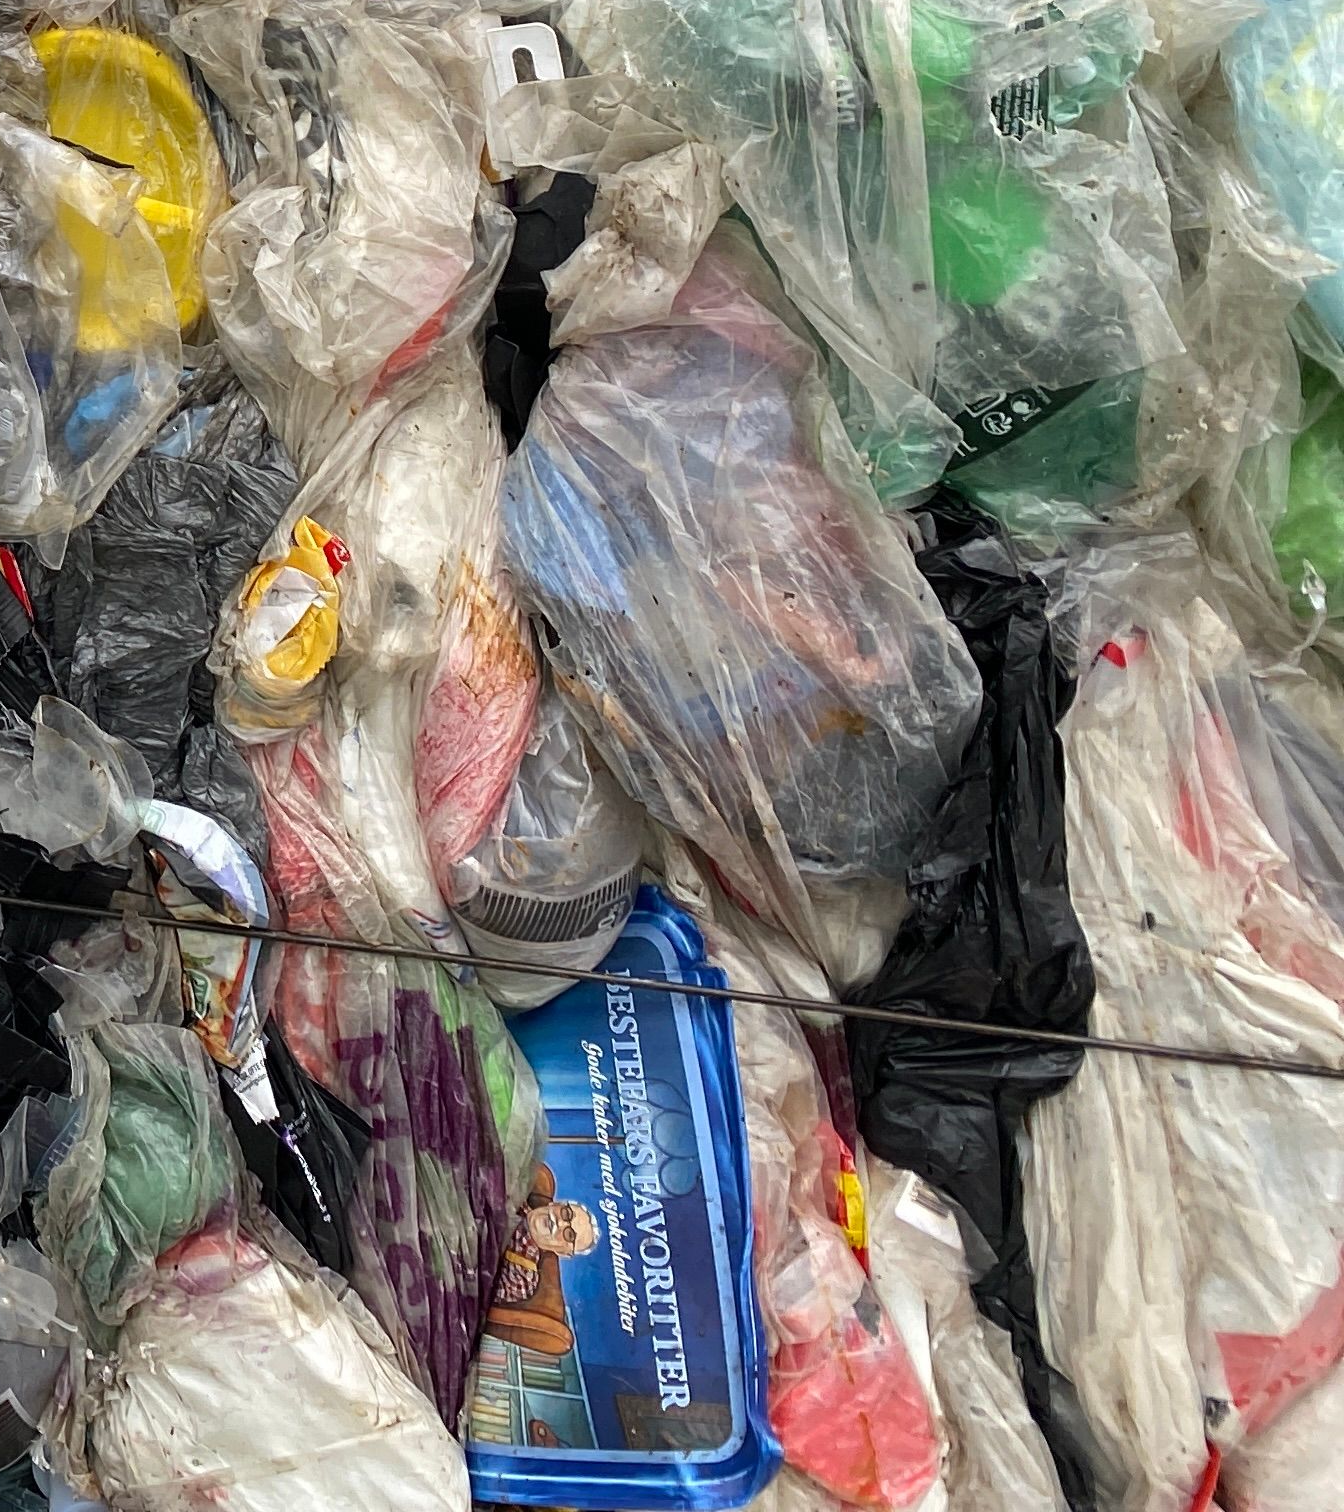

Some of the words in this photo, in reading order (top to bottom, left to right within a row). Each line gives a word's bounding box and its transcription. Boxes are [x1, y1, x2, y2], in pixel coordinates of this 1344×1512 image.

[581, 1040, 607, 1091] Gode
[605, 969, 657, 1166] BESTEFARS
[592, 1092, 613, 1149] kaker
[598, 1152, 623, 1196] med
[599, 1192, 640, 1336] sjokoladebiter
[630, 1172, 691, 1411] FAVORITTER
